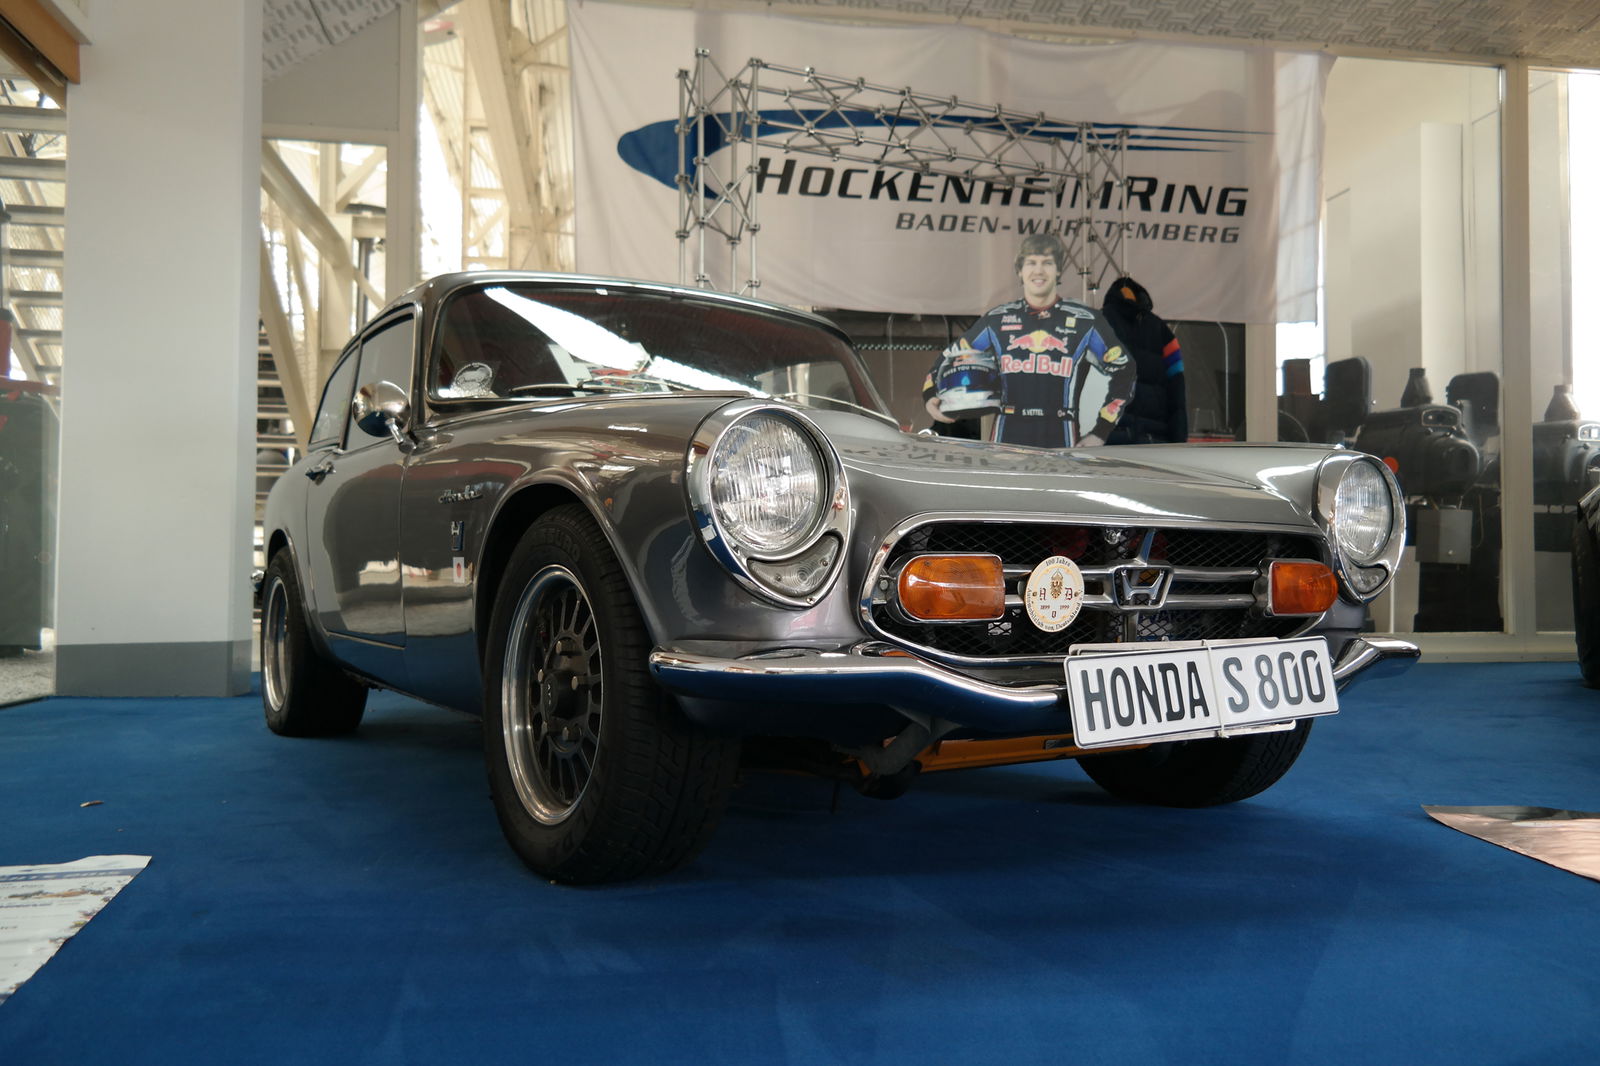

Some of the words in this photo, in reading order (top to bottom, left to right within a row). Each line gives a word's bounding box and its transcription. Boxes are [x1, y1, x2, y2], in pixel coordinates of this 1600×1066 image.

[1001, 353, 1036, 374] Red
[1036, 354, 1073, 377] Bull
[1080, 660, 1210, 732] HONDA
[1222, 656, 1250, 713] S
[1255, 650, 1326, 710] 800
